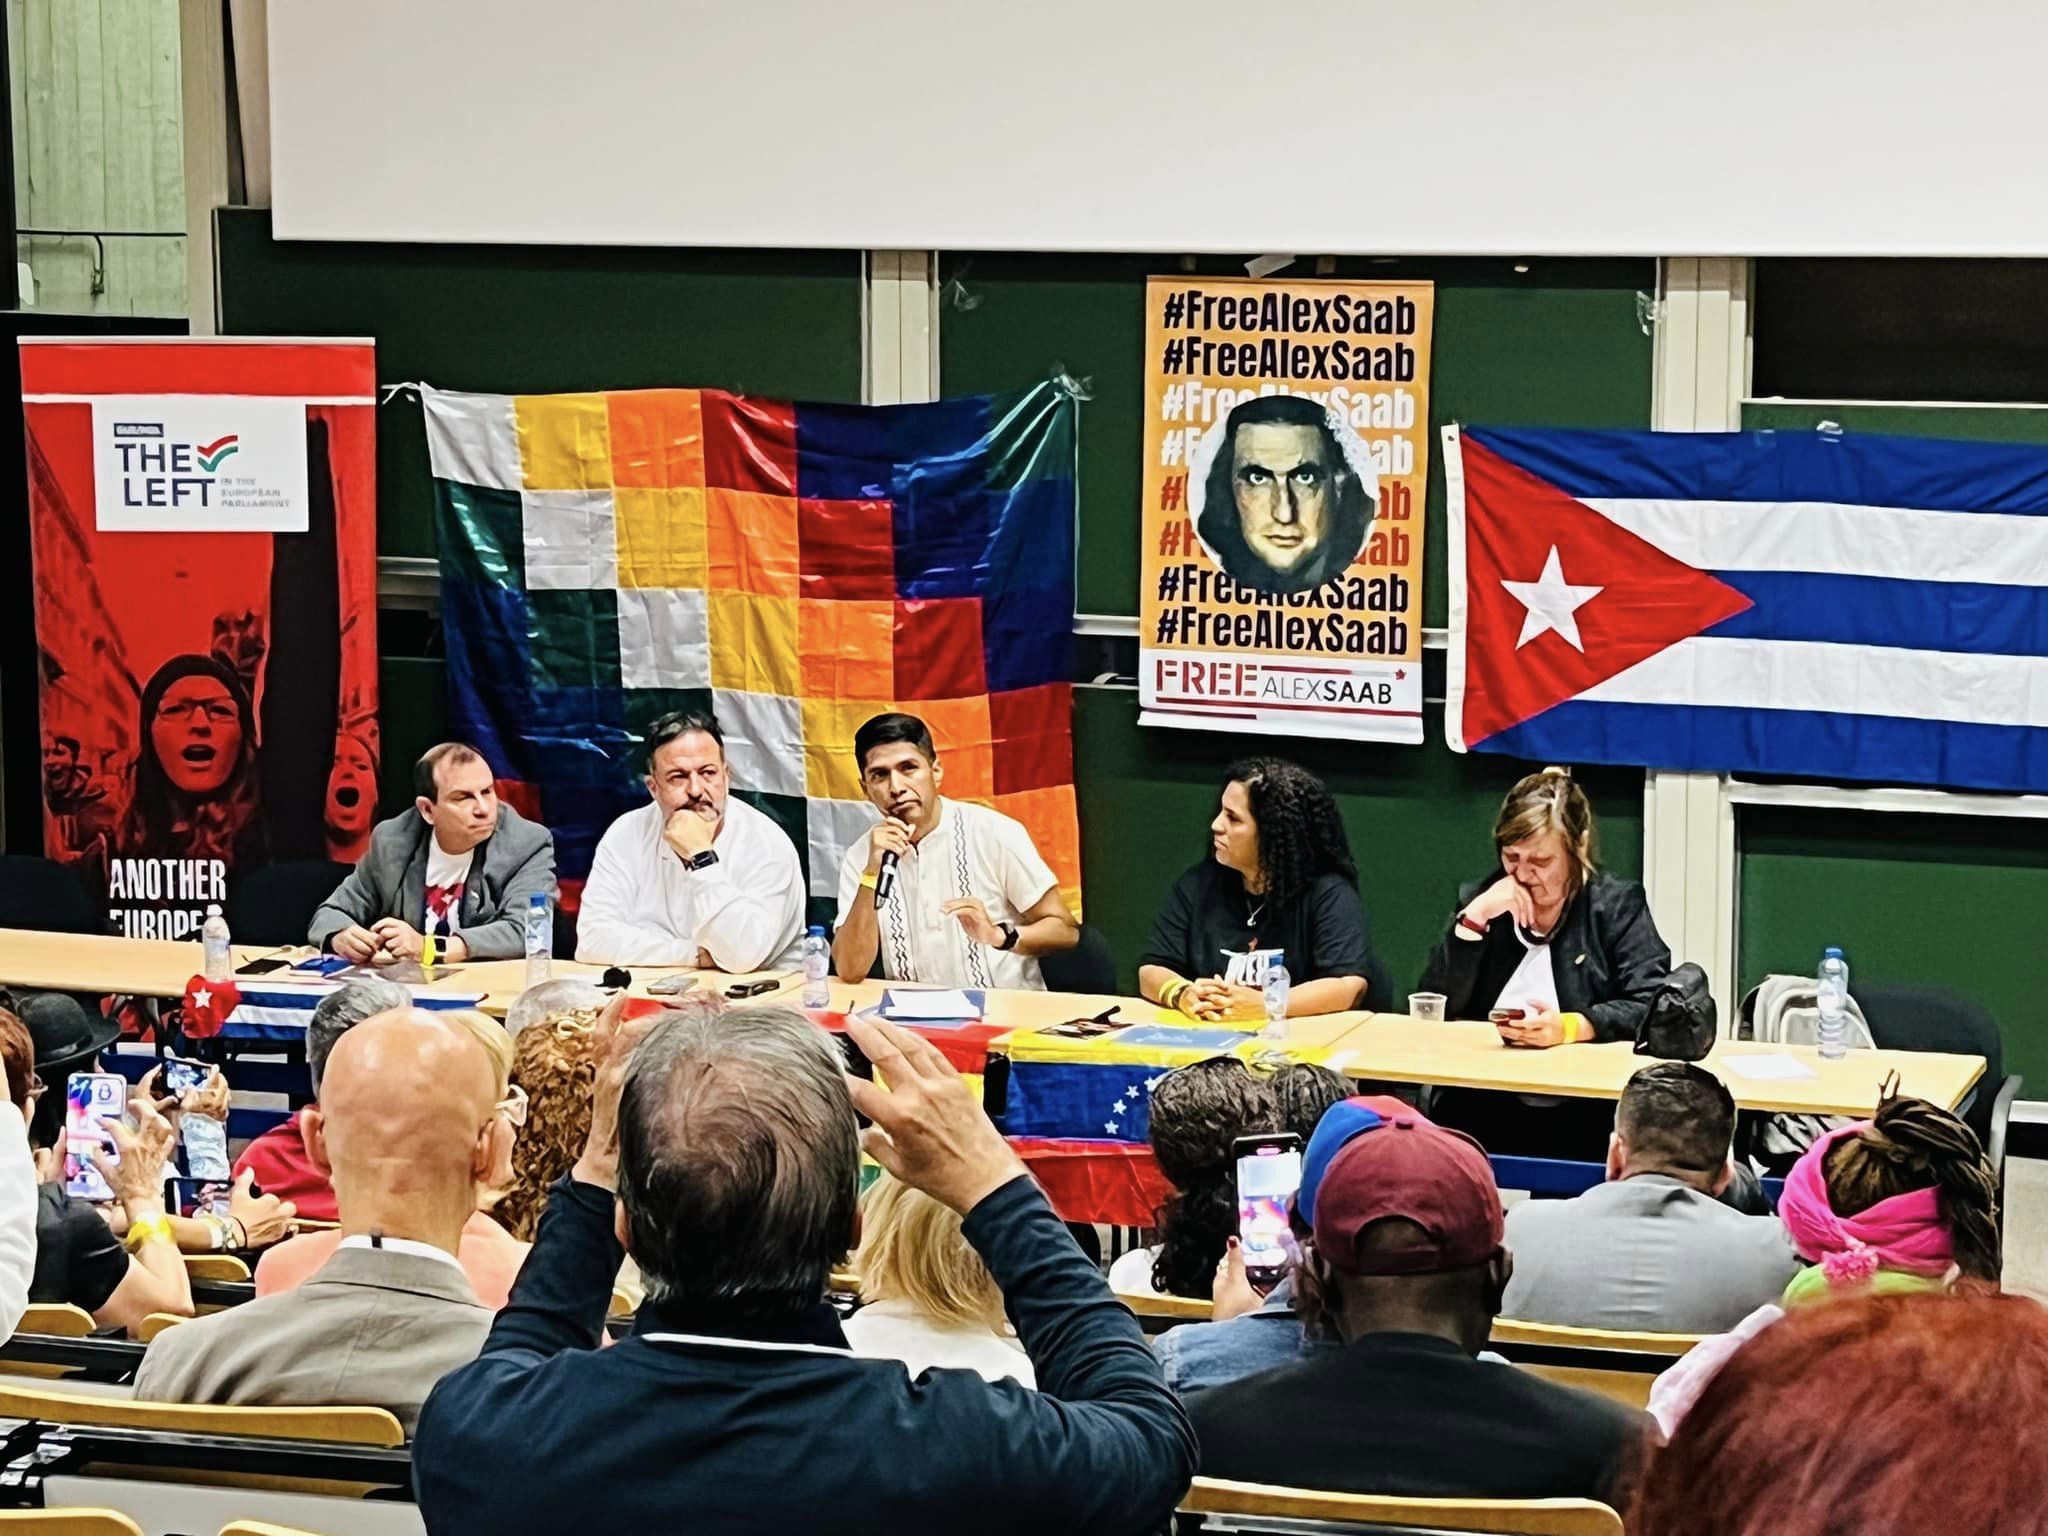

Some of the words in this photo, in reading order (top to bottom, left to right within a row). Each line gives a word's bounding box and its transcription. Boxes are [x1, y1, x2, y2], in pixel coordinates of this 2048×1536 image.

[1163, 290, 1416, 336] #FreeAlexSaab
[1162, 336, 1415, 382] #FreeAlexSaab
[114, 442, 192, 473] THE
[123, 477, 216, 507] LEFT
[1156, 606, 1408, 656] #FreeAlexSaab
[1156, 659, 1258, 697] FREE
[109, 858, 226, 900] ANOTHER
